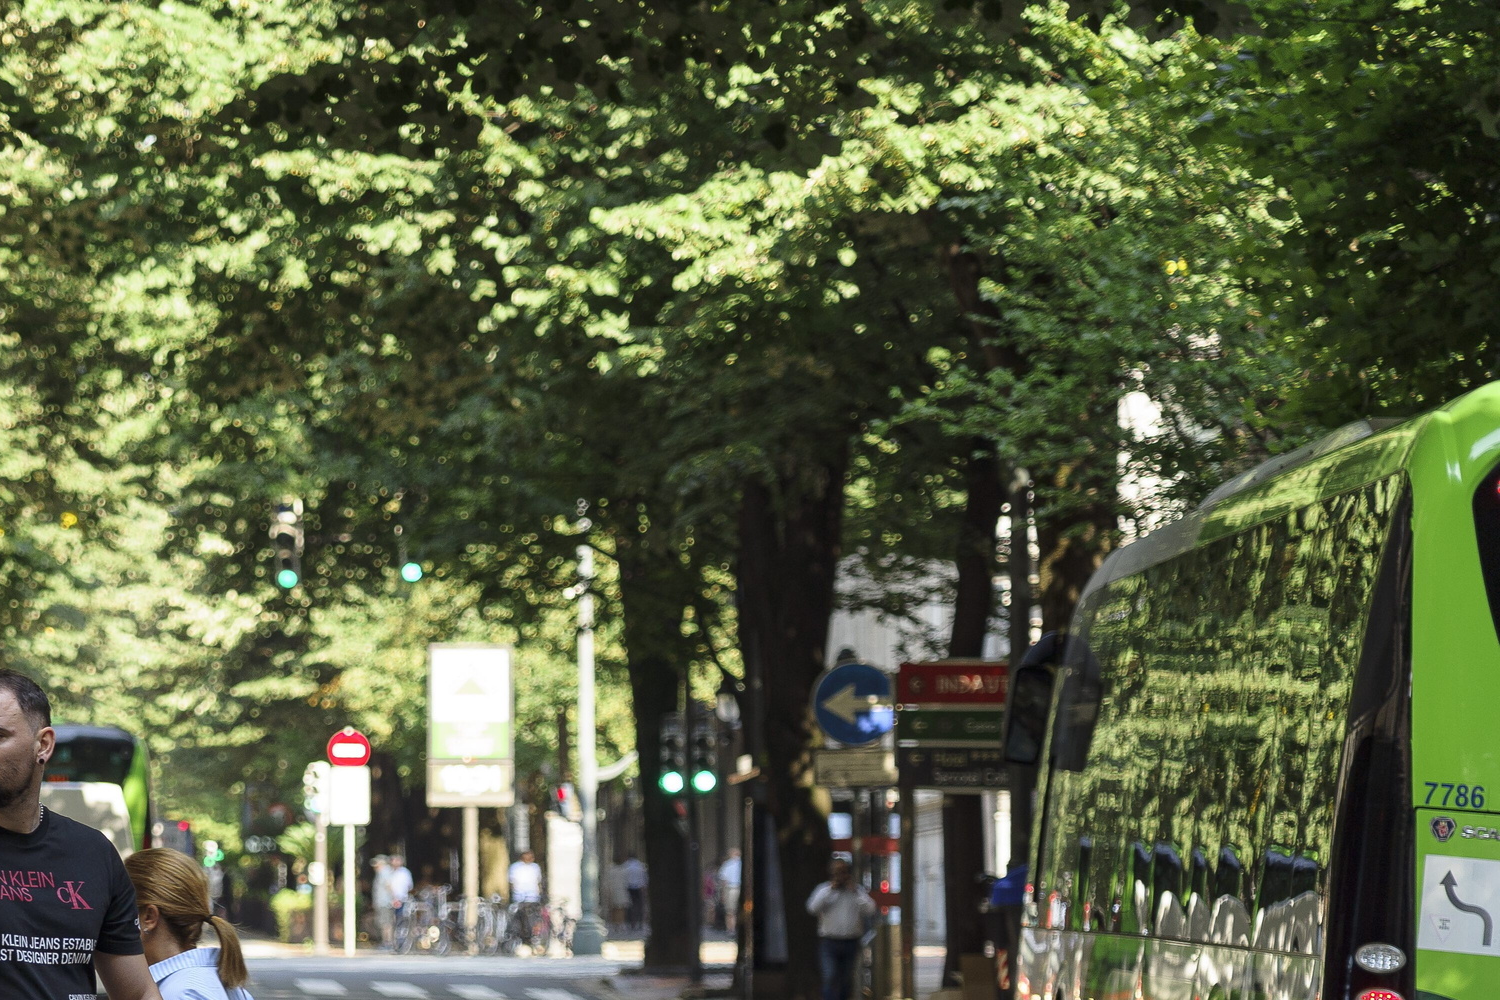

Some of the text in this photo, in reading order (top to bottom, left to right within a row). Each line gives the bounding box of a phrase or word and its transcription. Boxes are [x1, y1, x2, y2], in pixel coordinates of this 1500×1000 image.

[1425, 782, 1485, 809] 7786
[9, 870, 55, 888] KLEIN
[1, 933, 28, 949] KLEIN
[29, 936, 60, 950] JEANS
[16, 949, 59, 965] DESIGNER
[61, 952, 92, 965] DENIM
